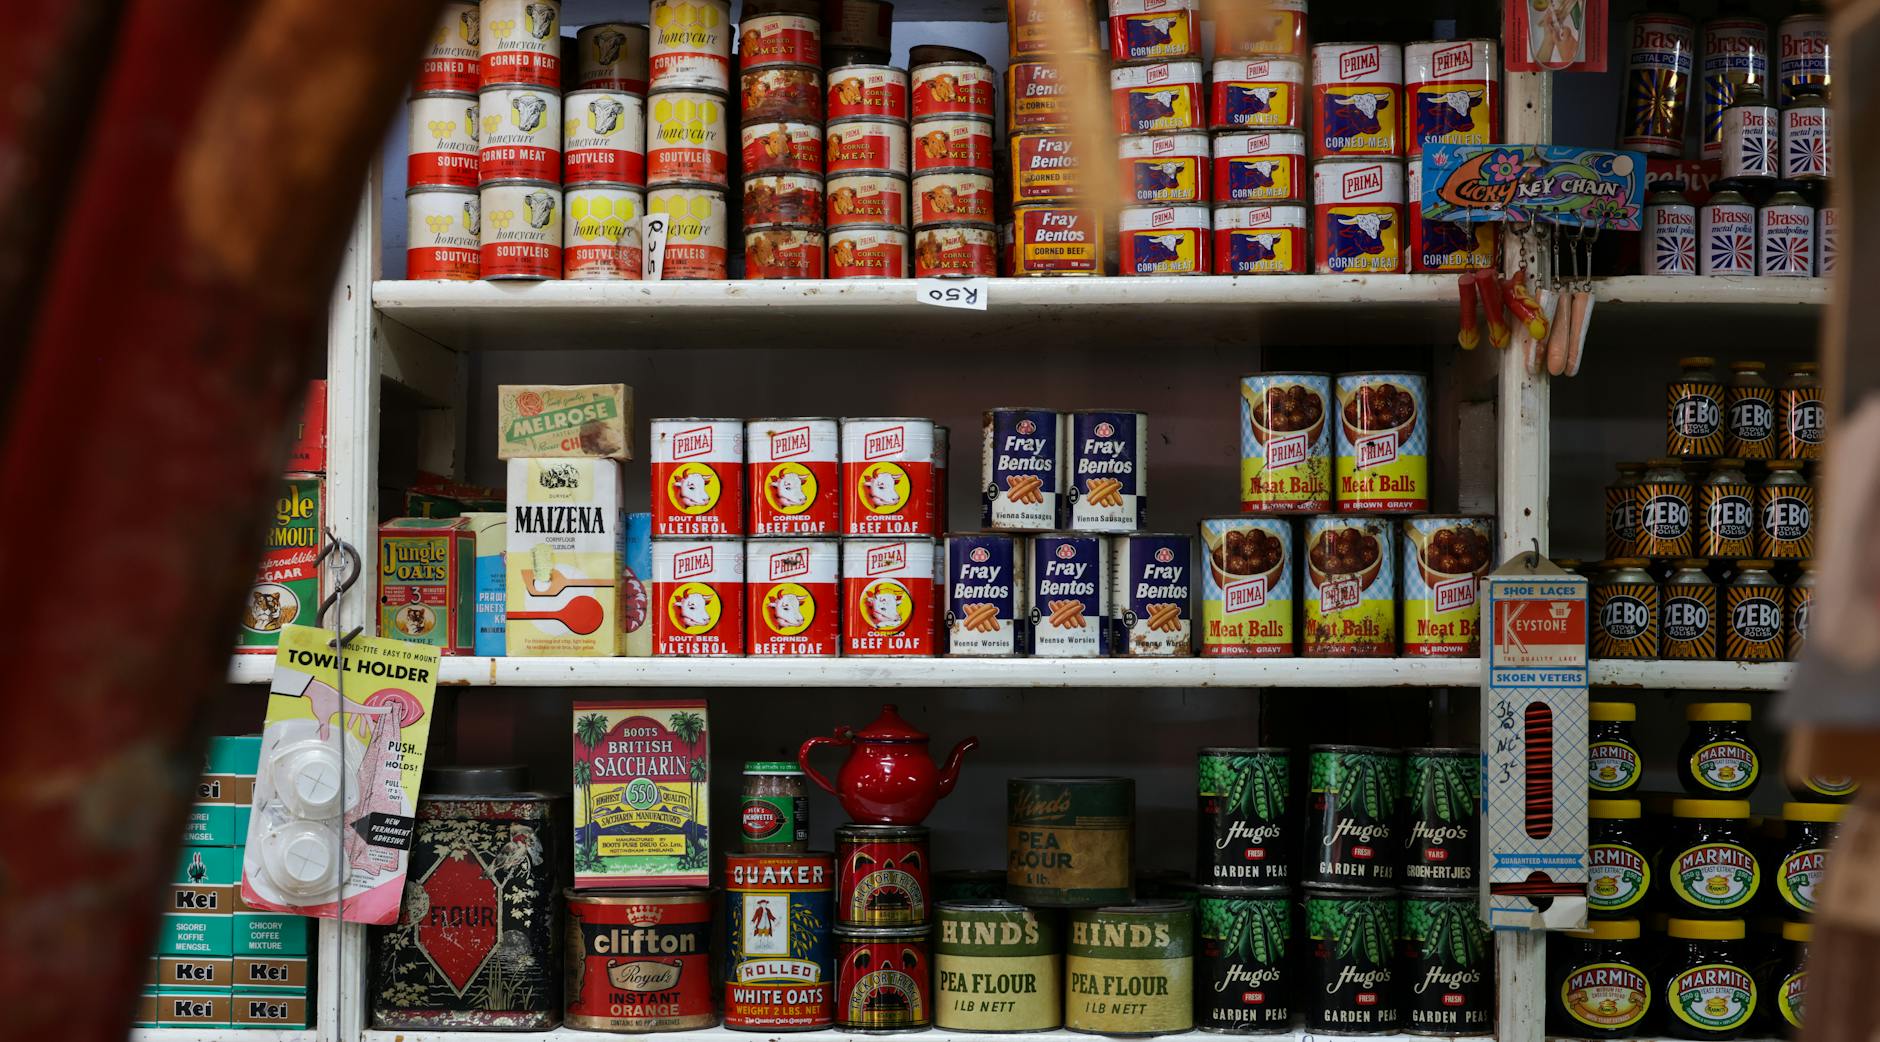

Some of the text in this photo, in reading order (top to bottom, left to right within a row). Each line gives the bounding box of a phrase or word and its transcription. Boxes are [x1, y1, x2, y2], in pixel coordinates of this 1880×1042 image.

[657, 30, 718, 47] honeycure
[1632, 29, 1693, 54] Brasso
[759, 45, 796, 55] MEAT
[490, 54, 556, 69] CORNED MEAT
[656, 125, 718, 143] honeycure
[519, 148, 547, 162] MEAT
[566, 151, 615, 165] SOUTVLEIS
[658, 151, 712, 165] SOUTVLEIS
[1518, 176, 1620, 198] KEY CHAIN
[1041, 212, 1078, 228] Fray
[1711, 207, 1753, 224] Brasso
[1766, 210, 1809, 226] Brasso
[1034, 228, 1084, 243] Bentos
[496, 245, 549, 260] SOUTVLEIS
[1033, 246, 1063, 256] CORNED
[1328, 255, 1399, 270] CORNED-MEAT
[929, 287, 978, 304] R50
[513, 402, 608, 438] MELROSE
[1672, 400, 1720, 430] ZEBO
[676, 435, 710, 453] PRIMA
[775, 434, 808, 453] PRIMA
[869, 434, 902, 453] PRIMA
[1004, 435, 1047, 454] Fray
[1083, 438, 1126, 457] Fray
[997, 454, 1053, 472] Bentos
[1077, 457, 1133, 475] Bentos
[1289, 476, 1324, 494] Balls
[1341, 474, 1416, 494] Meat Balls
[1352, 501, 1414, 509] BROWN GRAVY
[515, 506, 606, 534] MAIZENA
[659, 523, 728, 534] VLEISROL
[758, 522, 826, 534] BEEF LOAF
[850, 522, 919, 534] BEEF LOAF
[383, 540, 447, 578] Jungle
[677, 554, 711, 573] PRIMA
[399, 564, 446, 581] OATS
[960, 563, 1002, 582] Fray
[1045, 560, 1088, 577] Fray
[410, 586, 421, 605] 3
[953, 582, 1009, 600] Bentos
[1039, 579, 1095, 596] Bentos
[1503, 587, 1576, 595] SHOE LACES
[1604, 601, 1648, 627] ZEBO
[1663, 601, 1707, 627] ZEBO
[1736, 603, 1780, 630] ZEBO
[1209, 618, 1284, 638] Meat Balls
[1416, 618, 1456, 637] Meat
[1502, 601, 1568, 654] KEYSTONE
[659, 643, 728, 655] VLEISROL
[754, 642, 823, 654] BEEF LOAF
[851, 637, 921, 649] BEEF LOAF
[1256, 645, 1282, 654] GRAVY
[1429, 645, 1463, 653] BROWN
[382, 646, 438, 664] EASY TO MOUNT
[357, 658, 429, 684] HOLDER
[1495, 673, 1583, 683] SKOEN VETERS
[623, 727, 659, 738] BOOTS
[607, 740, 673, 754] BRITISH
[1700, 746, 1753, 764] MARMITE
[385, 759, 419, 772] HOLDS!
[593, 755, 688, 777] SACCHARIN
[595, 793, 621, 805] HIGHEST
[629, 783, 655, 804] 550
[662, 792, 688, 805] QUALITY
[384, 816, 401, 826] NEW
[371, 825, 411, 837] PERMANENT
[1215, 819, 1281, 850] Hugo's
[1322, 817, 1391, 847] Hugo's
[1404, 819, 1469, 849] Hugo's
[372, 834, 406, 846] ADHESIVE
[1018, 831, 1060, 850] PEA
[1246, 848, 1265, 858] FRESH
[1353, 847, 1372, 857] FRESH
[1427, 849, 1445, 859] VARS
[1682, 847, 1753, 870] MARMITE
[1009, 852, 1073, 870] FLOUR
[733, 865, 825, 886] QUAKER
[1213, 863, 1288, 878] GARDEN PEAS
[1372, 865, 1394, 879] PEAS
[1406, 864, 1472, 880] GROEN-ERTJIES
[175, 889, 218, 910] Kei
[175, 922, 208, 932] SIGOREI
[248, 921, 284, 931] CHICORY
[941, 920, 1040, 946] HINDS
[1071, 921, 1171, 948] HINDS
[176, 932, 205, 942] KOFFIE
[250, 931, 281, 941] COFFEE
[593, 927, 696, 954] clifton
[174, 941, 212, 952] MENGSEL
[248, 940, 283, 951] MIXTURE
[174, 963, 214, 981] Kei
[248, 963, 288, 981] Kei
[744, 962, 812, 978] ROLLED
[871, 972, 888, 982] OR
[1214, 963, 1281, 993] Hugo's
[940, 970, 1038, 995] PEA FLOUR
[1071, 972, 1169, 997] PEA FLOUR
[1325, 964, 1392, 994] Hugo's
[1570, 969, 1645, 993] MARMITE
[1679, 969, 1750, 992] MARMITE
[608, 992, 681, 1004] INSTANT
[733, 988, 825, 1005] WHITE OATS
[1244, 993, 1263, 1002] FRESH
[1357, 993, 1376, 1003] FRESH
[173, 1000, 213, 1018] Kei
[248, 1001, 288, 1019] Kei
[610, 1003, 680, 1017] ORANGE
[736, 1005, 821, 1016] WEIGHT 2 LBS. NET
[960, 1000, 1017, 1013] LB NETT
[1092, 1003, 1148, 1016] LB NETT
[1212, 1007, 1288, 1023] GARDEN PEAS
[1323, 1008, 1371, 1024] GARDEN
[1412, 1009, 1457, 1024] GARDEN
